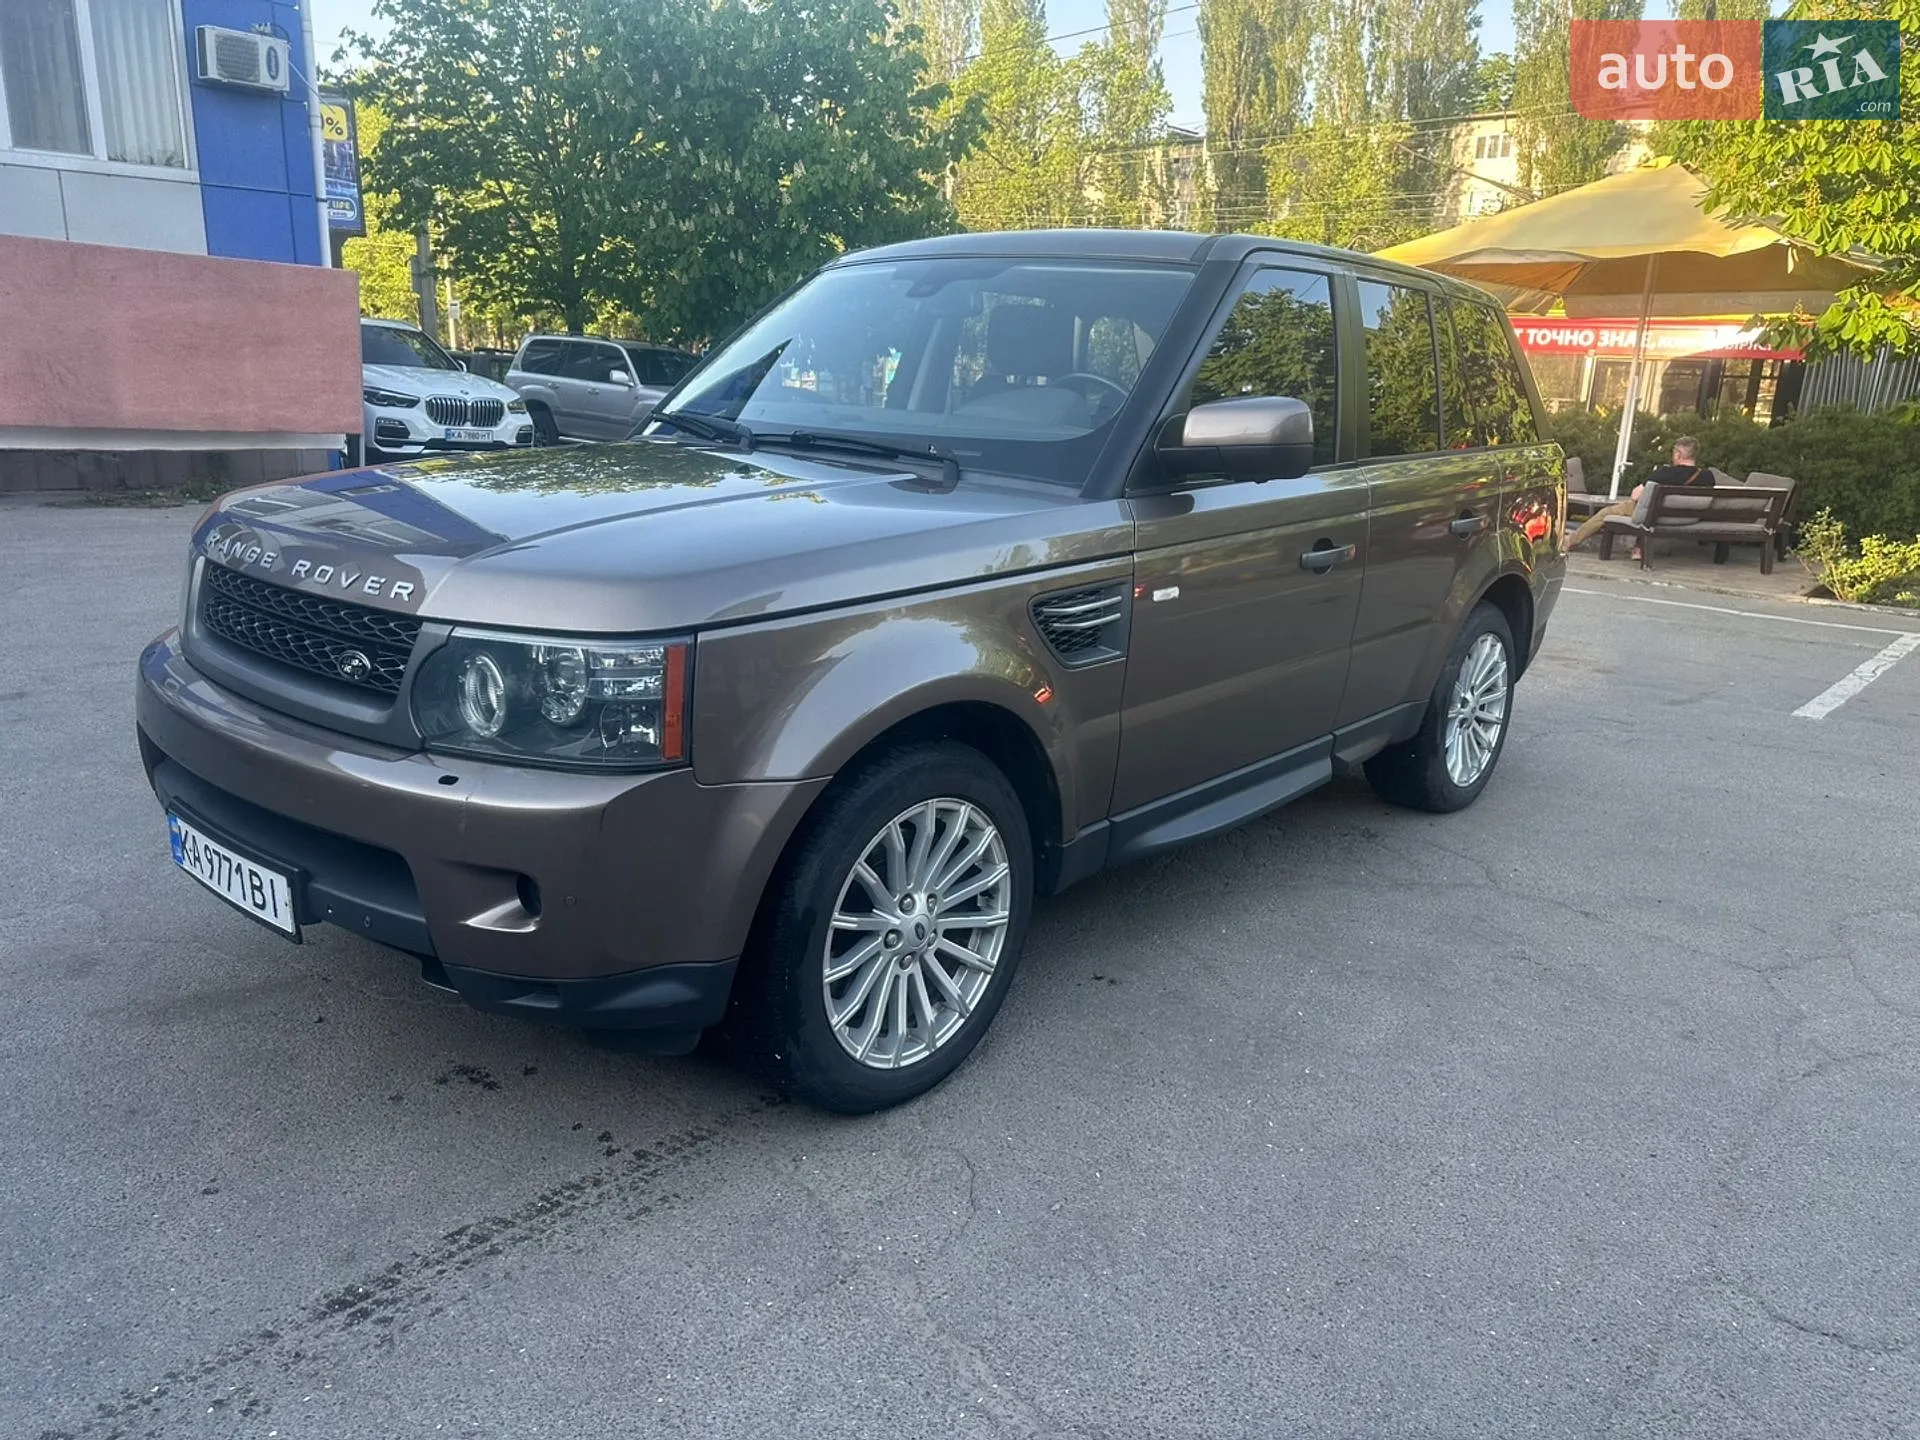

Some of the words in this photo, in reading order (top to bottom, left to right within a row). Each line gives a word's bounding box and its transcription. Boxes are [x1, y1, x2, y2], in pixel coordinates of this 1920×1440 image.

[1526, 328, 1595, 347] ТОЧНО
[206, 529, 279, 569] RANGE
[291, 559, 415, 602] ROVER
